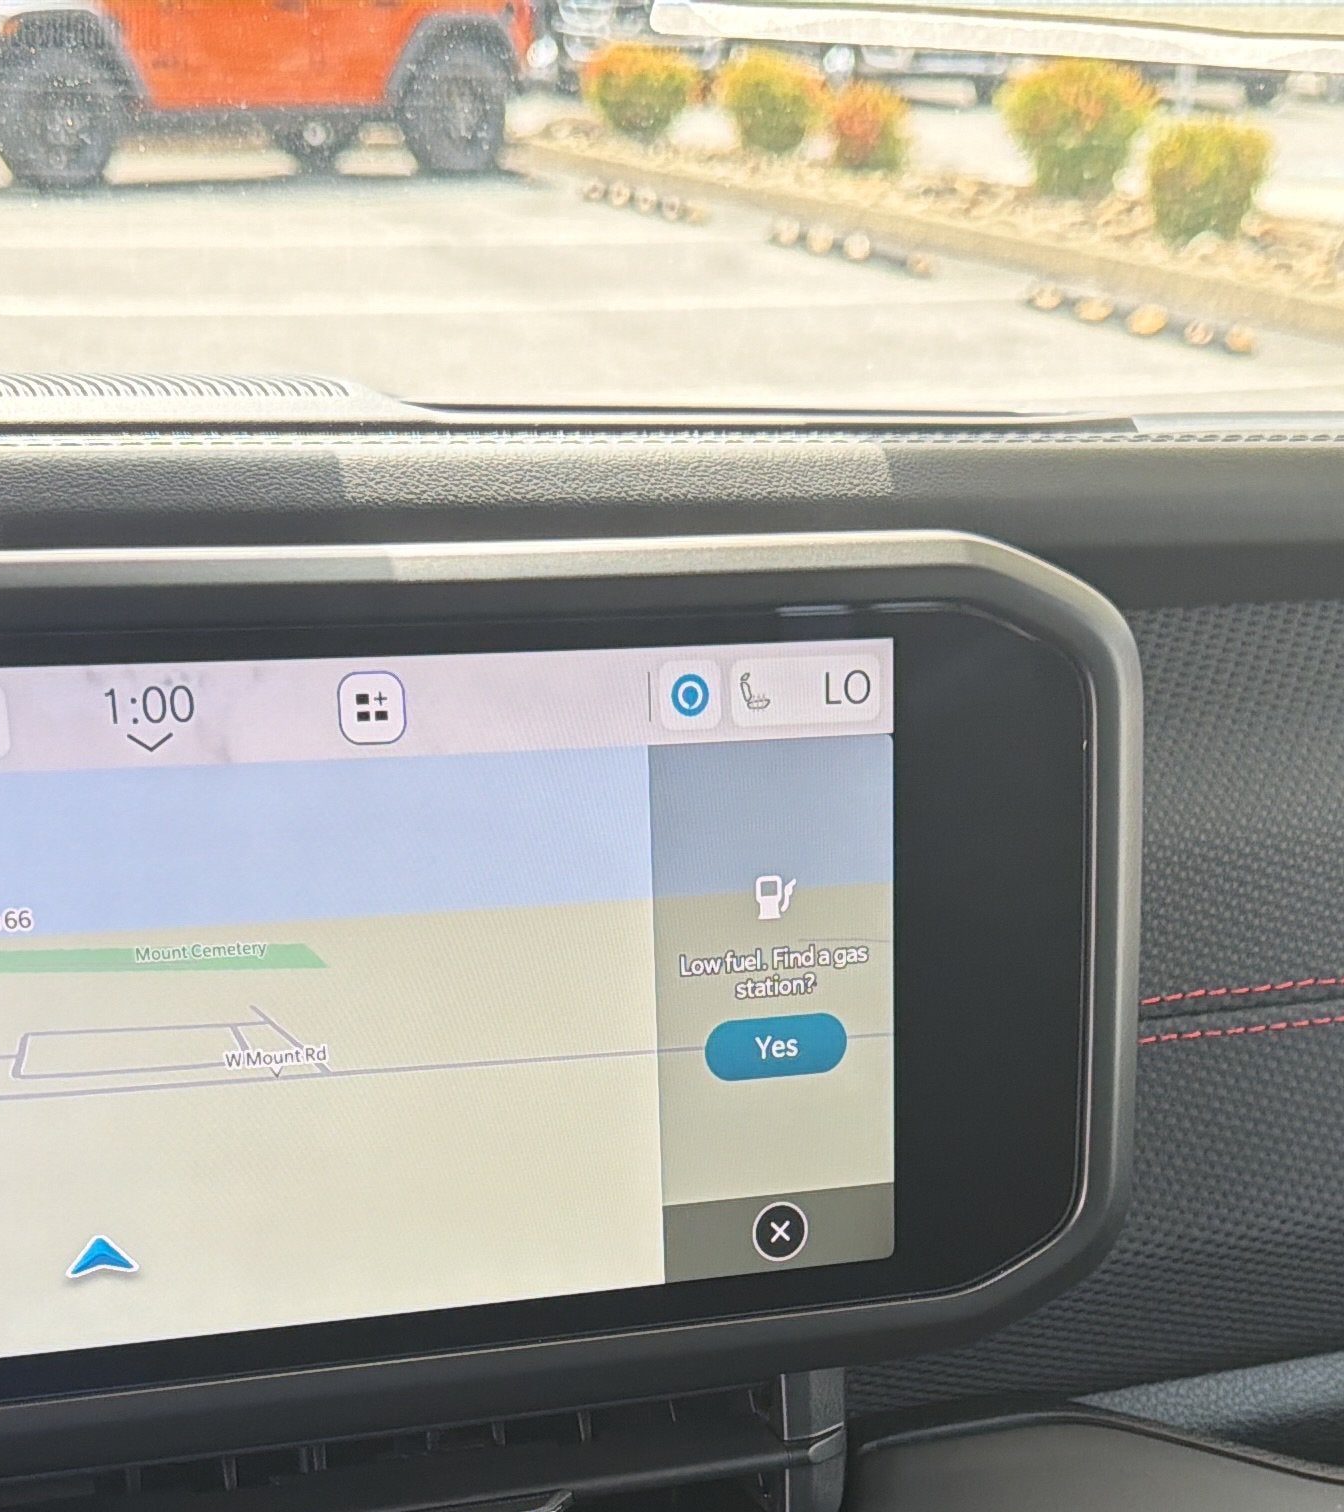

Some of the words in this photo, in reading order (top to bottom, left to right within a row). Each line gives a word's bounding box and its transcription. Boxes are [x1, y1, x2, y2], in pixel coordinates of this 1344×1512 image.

[823, 669, 872, 705] LO
[104, 684, 196, 726] 1:00
[4, 910, 33, 931] 66
[135, 945, 188, 962] Mount
[191, 941, 267, 962] Cemetery
[680, 955, 722, 977] Low
[725, 949, 768, 974] fuel.
[772, 944, 815, 969] Find
[818, 952, 831, 966] a
[834, 946, 869, 968] gas
[735, 973, 817, 999] station?
[224, 1052, 245, 1068] W
[246, 1048, 301, 1067] Mount
[304, 1044, 327, 1063] Rd
[755, 1035, 799, 1060] Yes
